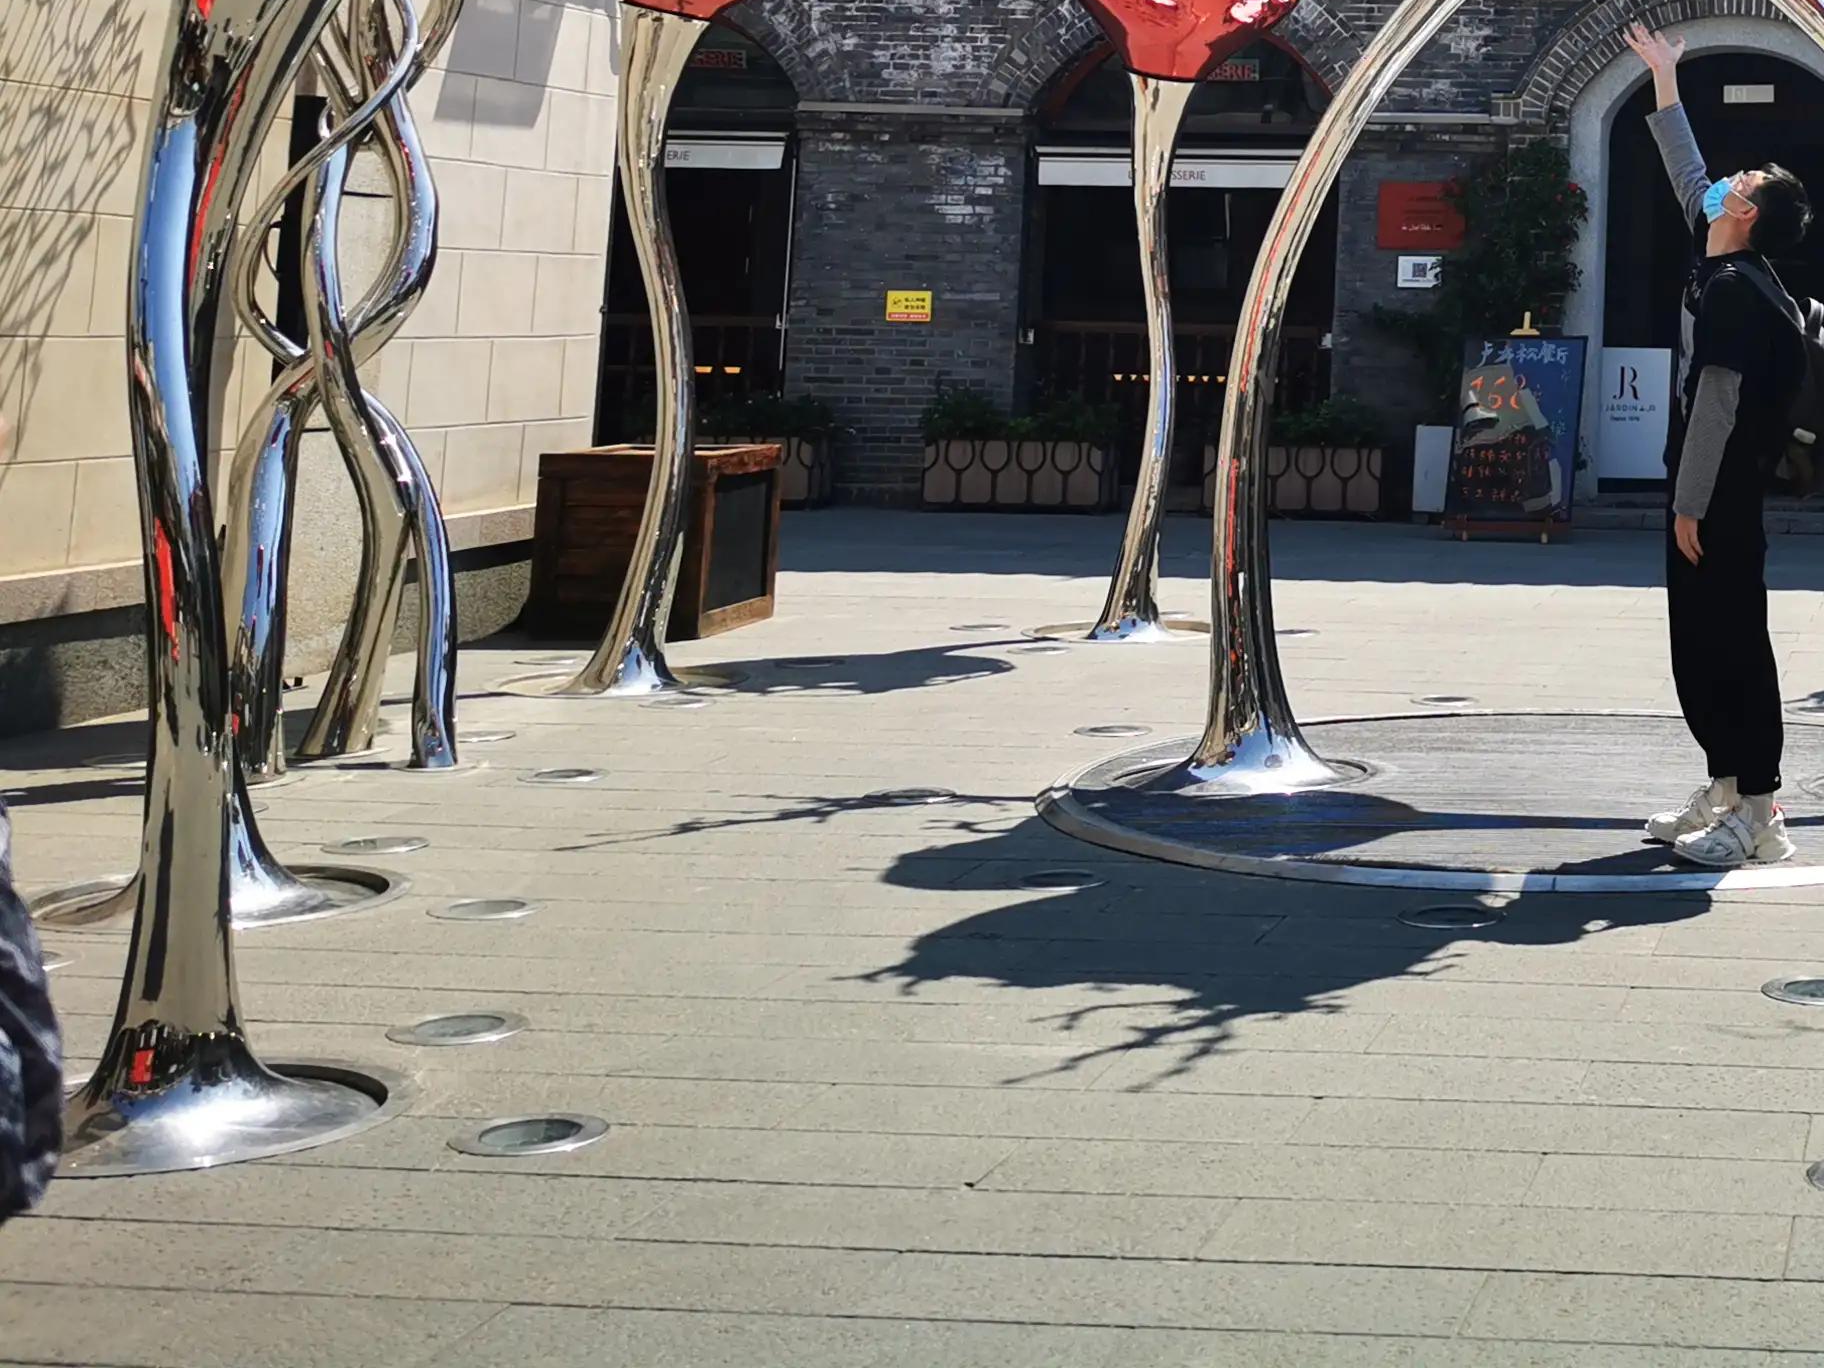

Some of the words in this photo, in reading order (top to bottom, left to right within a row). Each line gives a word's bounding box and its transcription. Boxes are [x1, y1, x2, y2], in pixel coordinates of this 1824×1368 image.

[666, 150, 691, 161] ERIE
[1170, 170, 1206, 181] SSERIE
[1612, 365, 1640, 401] JR
